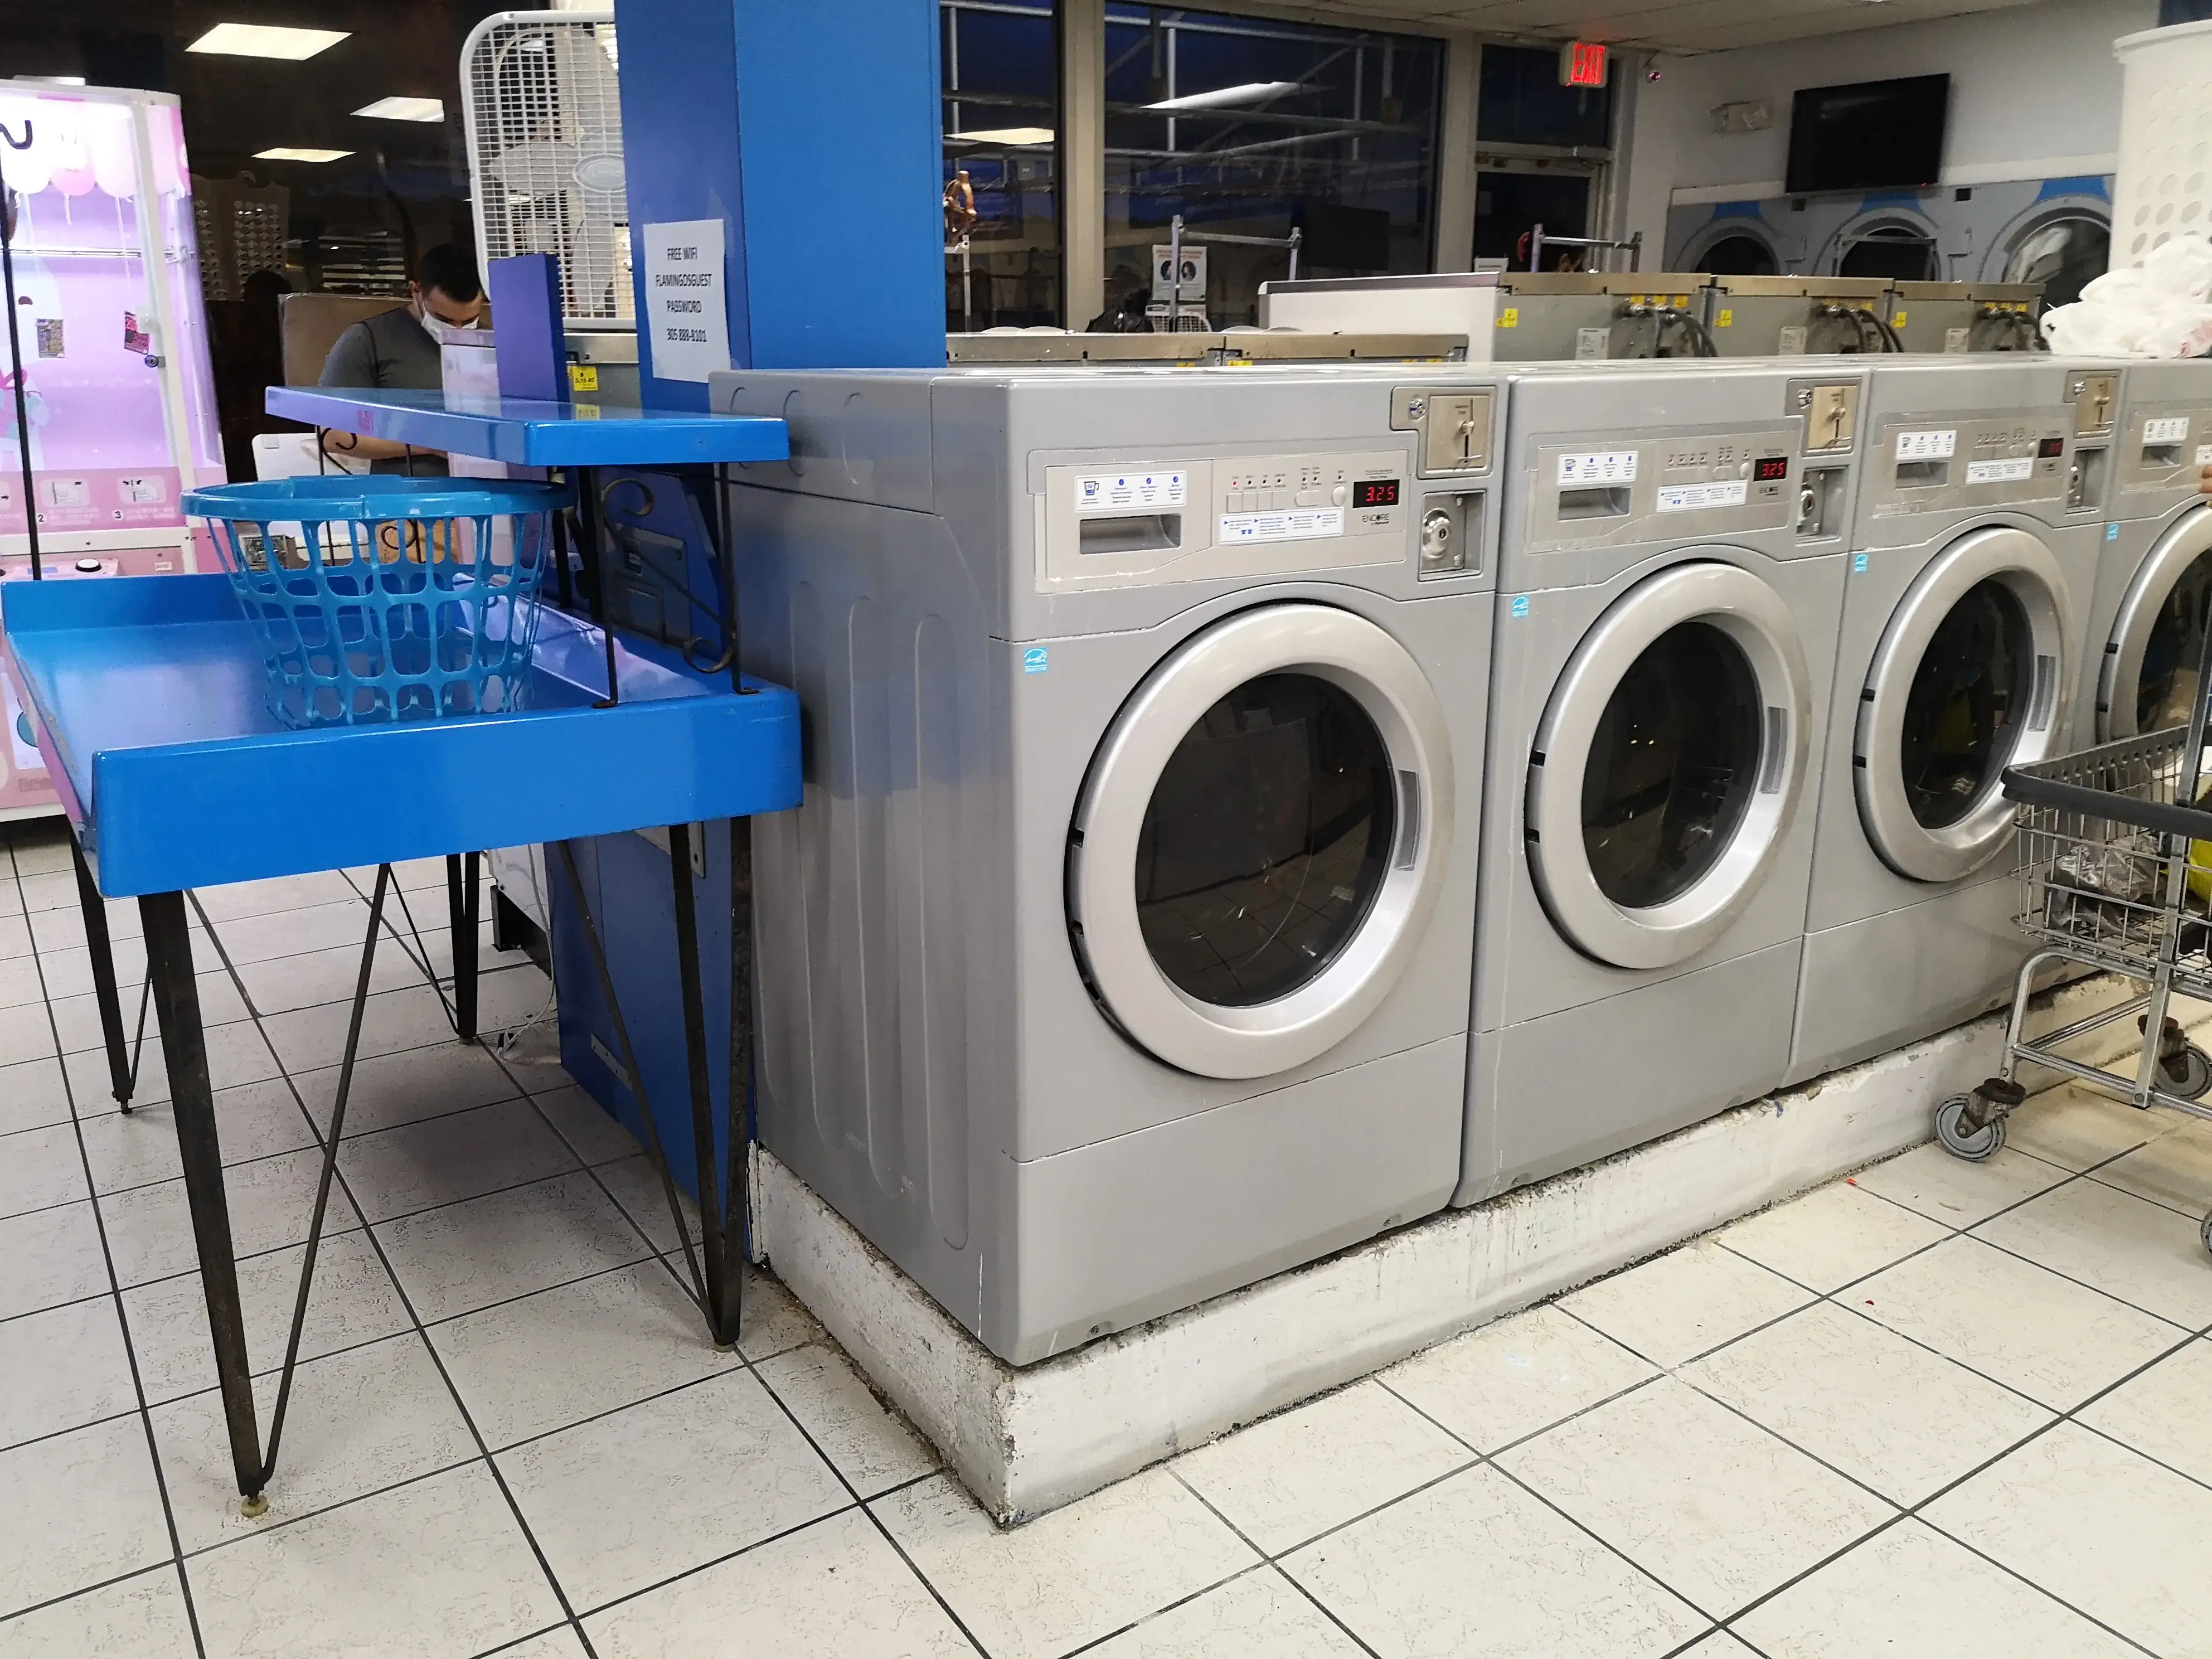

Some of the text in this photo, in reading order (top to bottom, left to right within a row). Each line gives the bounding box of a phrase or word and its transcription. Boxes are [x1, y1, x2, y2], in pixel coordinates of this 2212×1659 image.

[1571, 43, 1605, 84] EXIT
[667, 247, 698, 260] FREE WIFI
[656, 274, 712, 287] FLAMINGOSGUEST
[667, 300, 702, 313] PASSWORD
[667, 328, 677, 341] 305
